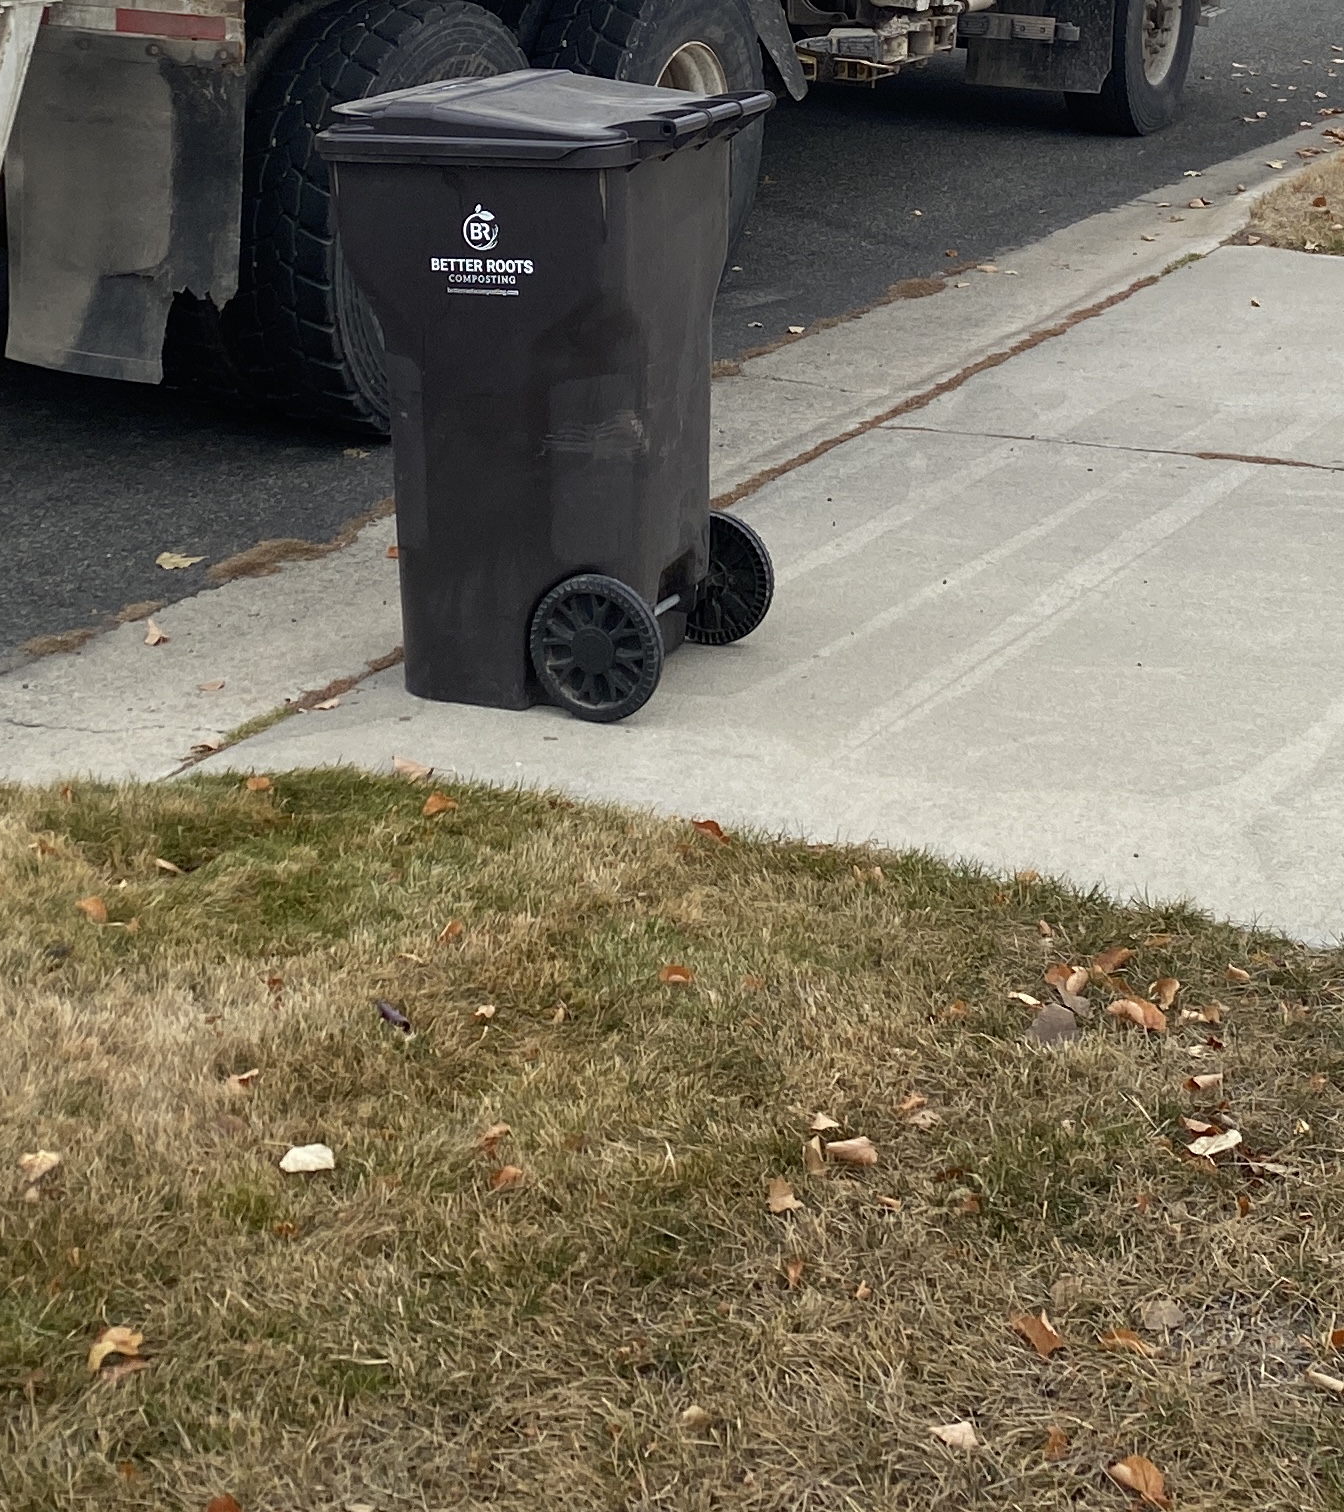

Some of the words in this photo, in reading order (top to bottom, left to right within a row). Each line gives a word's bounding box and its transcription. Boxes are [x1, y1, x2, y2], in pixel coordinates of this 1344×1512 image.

[469, 222, 491, 241] BR
[430, 257, 483, 273] BETTER
[486, 258, 534, 274] ROOTS
[448, 273, 517, 285] COMPOSTING
